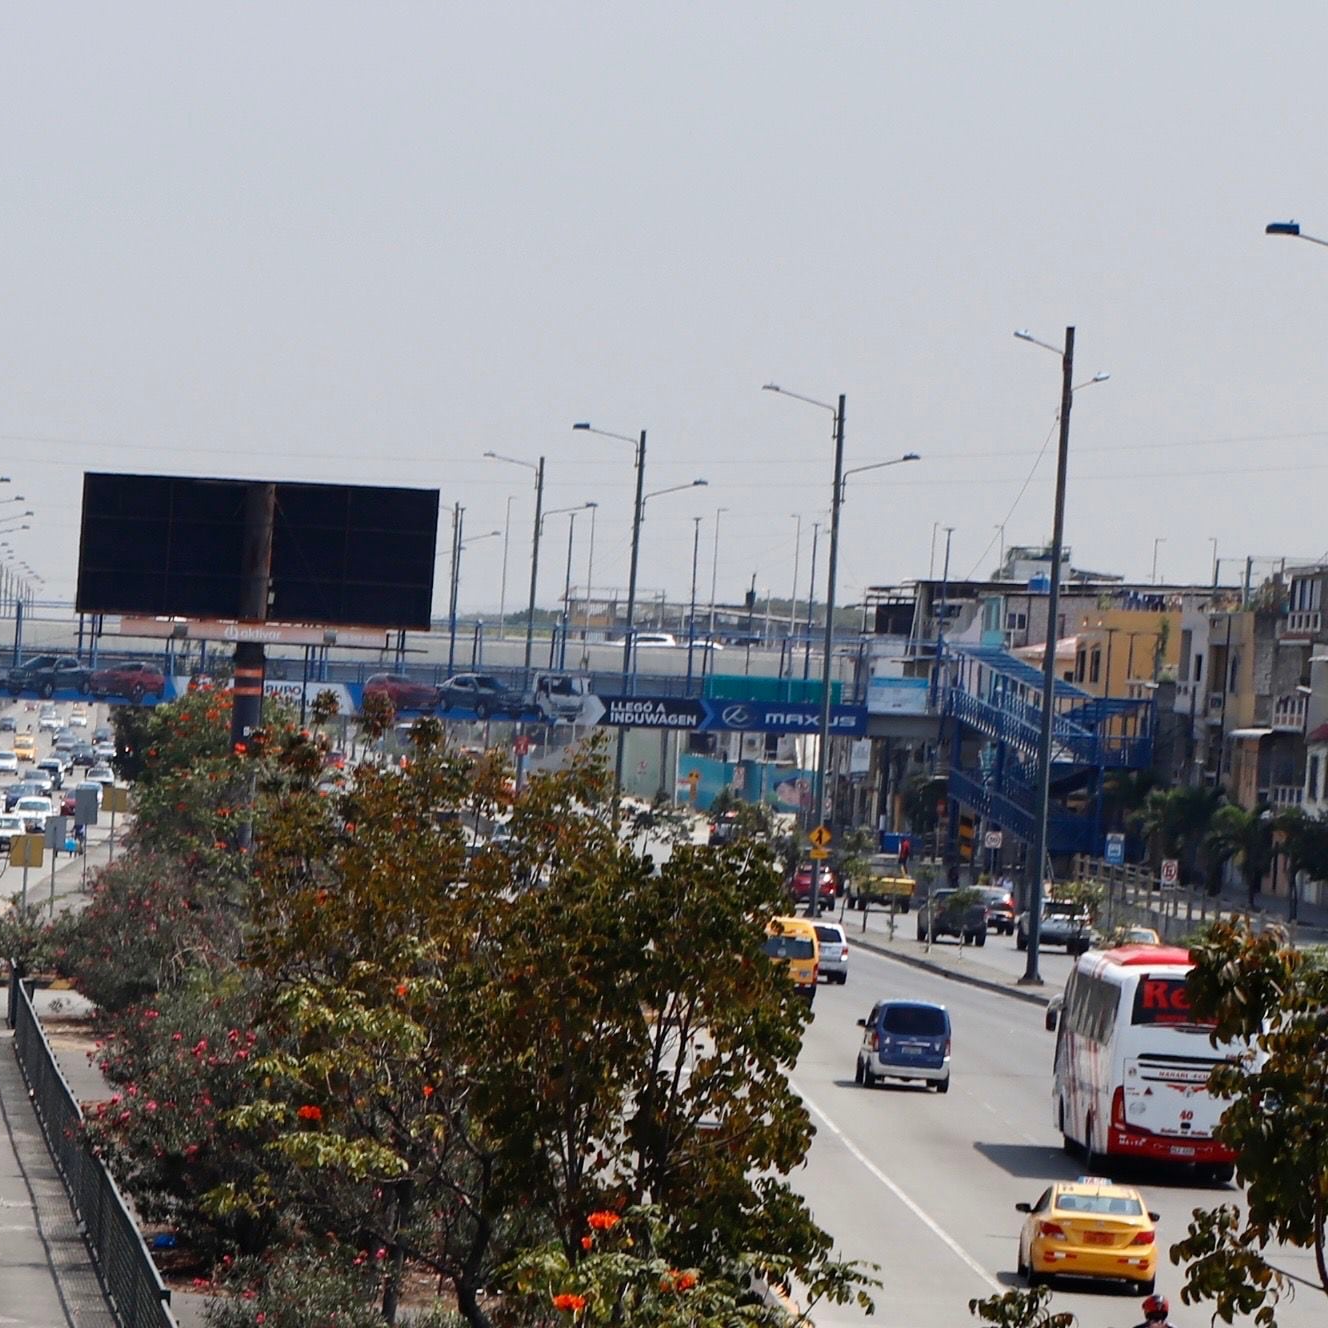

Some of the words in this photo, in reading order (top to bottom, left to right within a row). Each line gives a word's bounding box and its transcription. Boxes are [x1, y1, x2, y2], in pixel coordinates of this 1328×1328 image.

[610, 701, 653, 713] LLEGÓ
[656, 704, 666, 713] A
[609, 711, 697, 726] INDUWAGEN
